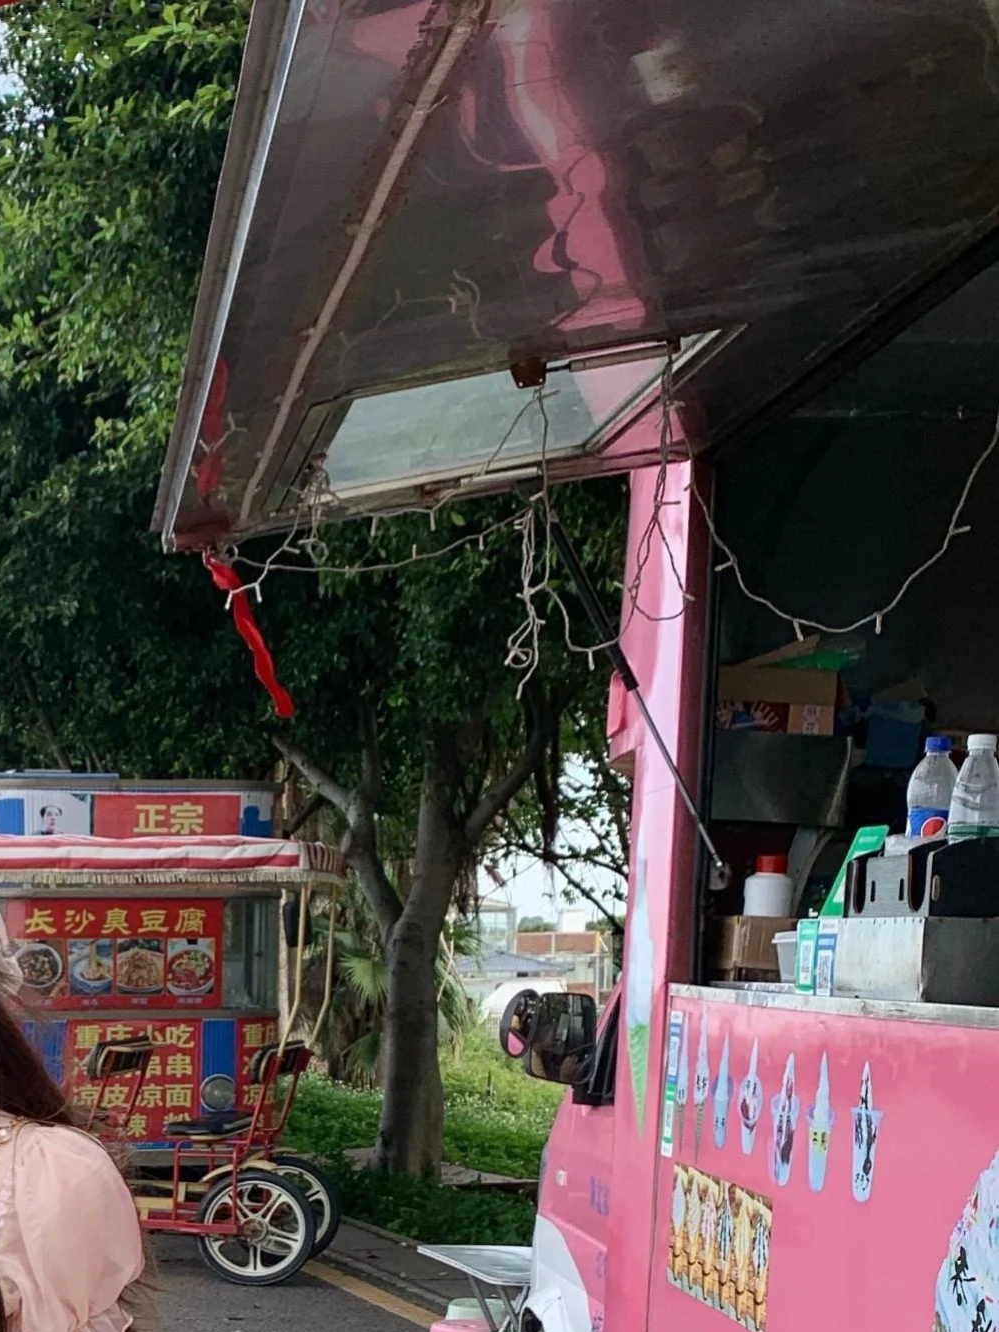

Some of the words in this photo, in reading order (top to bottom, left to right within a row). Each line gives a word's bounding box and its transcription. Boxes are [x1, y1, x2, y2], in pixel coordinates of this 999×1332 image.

[133, 802, 204, 834] 正宗
[25, 907, 207, 935] 长沙臭豆腐
[72, 1083, 194, 1108] 凉皮凉面
